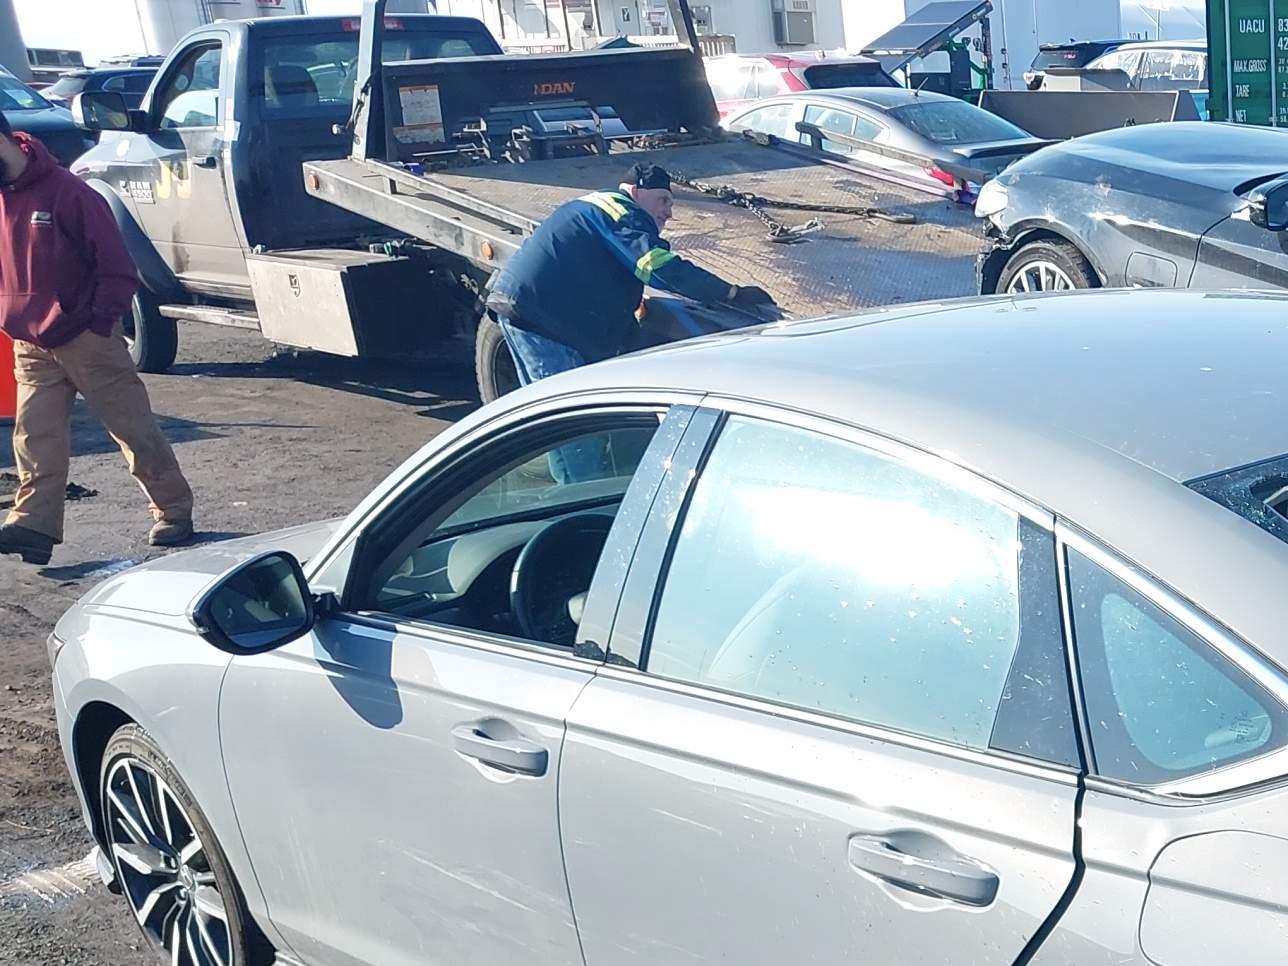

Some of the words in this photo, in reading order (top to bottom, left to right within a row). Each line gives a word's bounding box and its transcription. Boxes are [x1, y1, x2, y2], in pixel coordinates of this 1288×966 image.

[1239, 19, 1265, 33] UACU
[1235, 84, 1250, 98] TARE
[1235, 109, 1247, 122] NET
